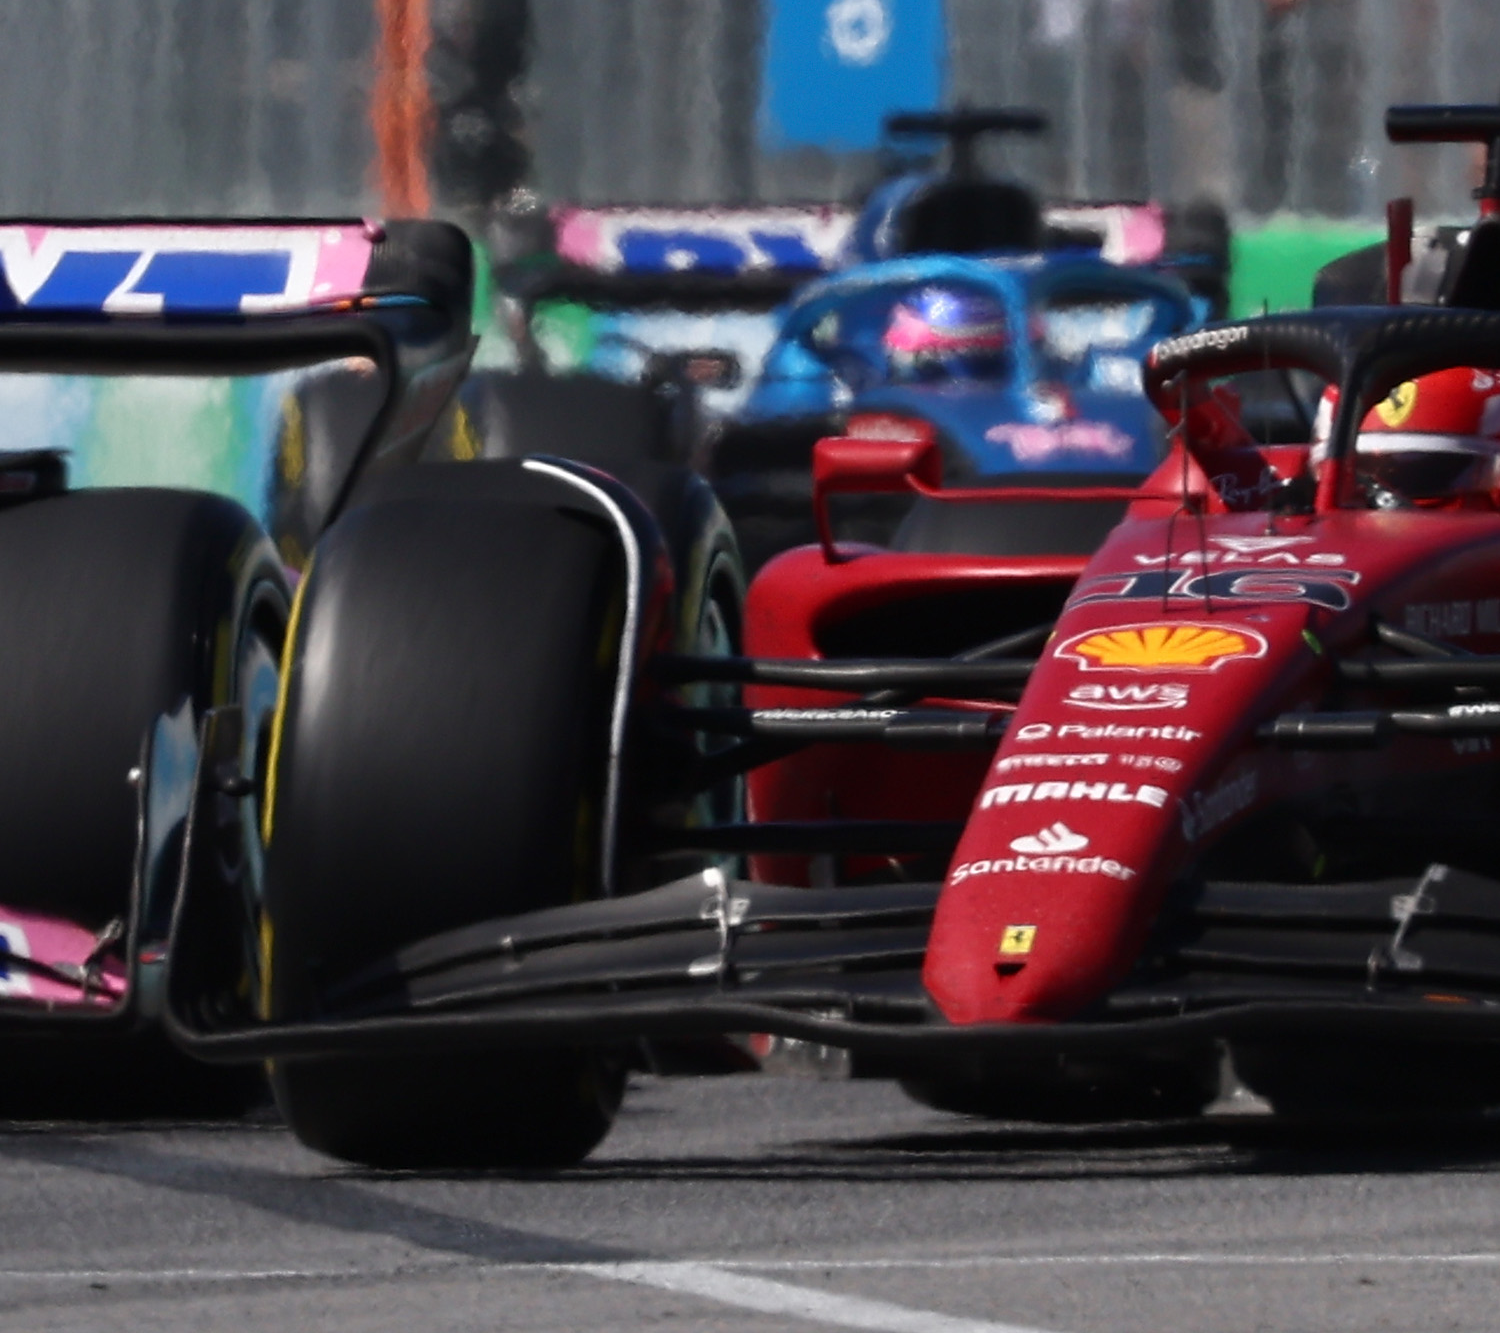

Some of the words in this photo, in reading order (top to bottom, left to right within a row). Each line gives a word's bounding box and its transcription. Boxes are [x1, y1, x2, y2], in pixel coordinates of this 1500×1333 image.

[1134, 549, 1346, 566] VELAS
[1066, 567, 1362, 611] 16
[1069, 683, 1189, 703] aws
[1057, 723, 1203, 742] Palantir
[980, 782, 1169, 810] MAHLE
[950, 855, 1137, 886] Santander
